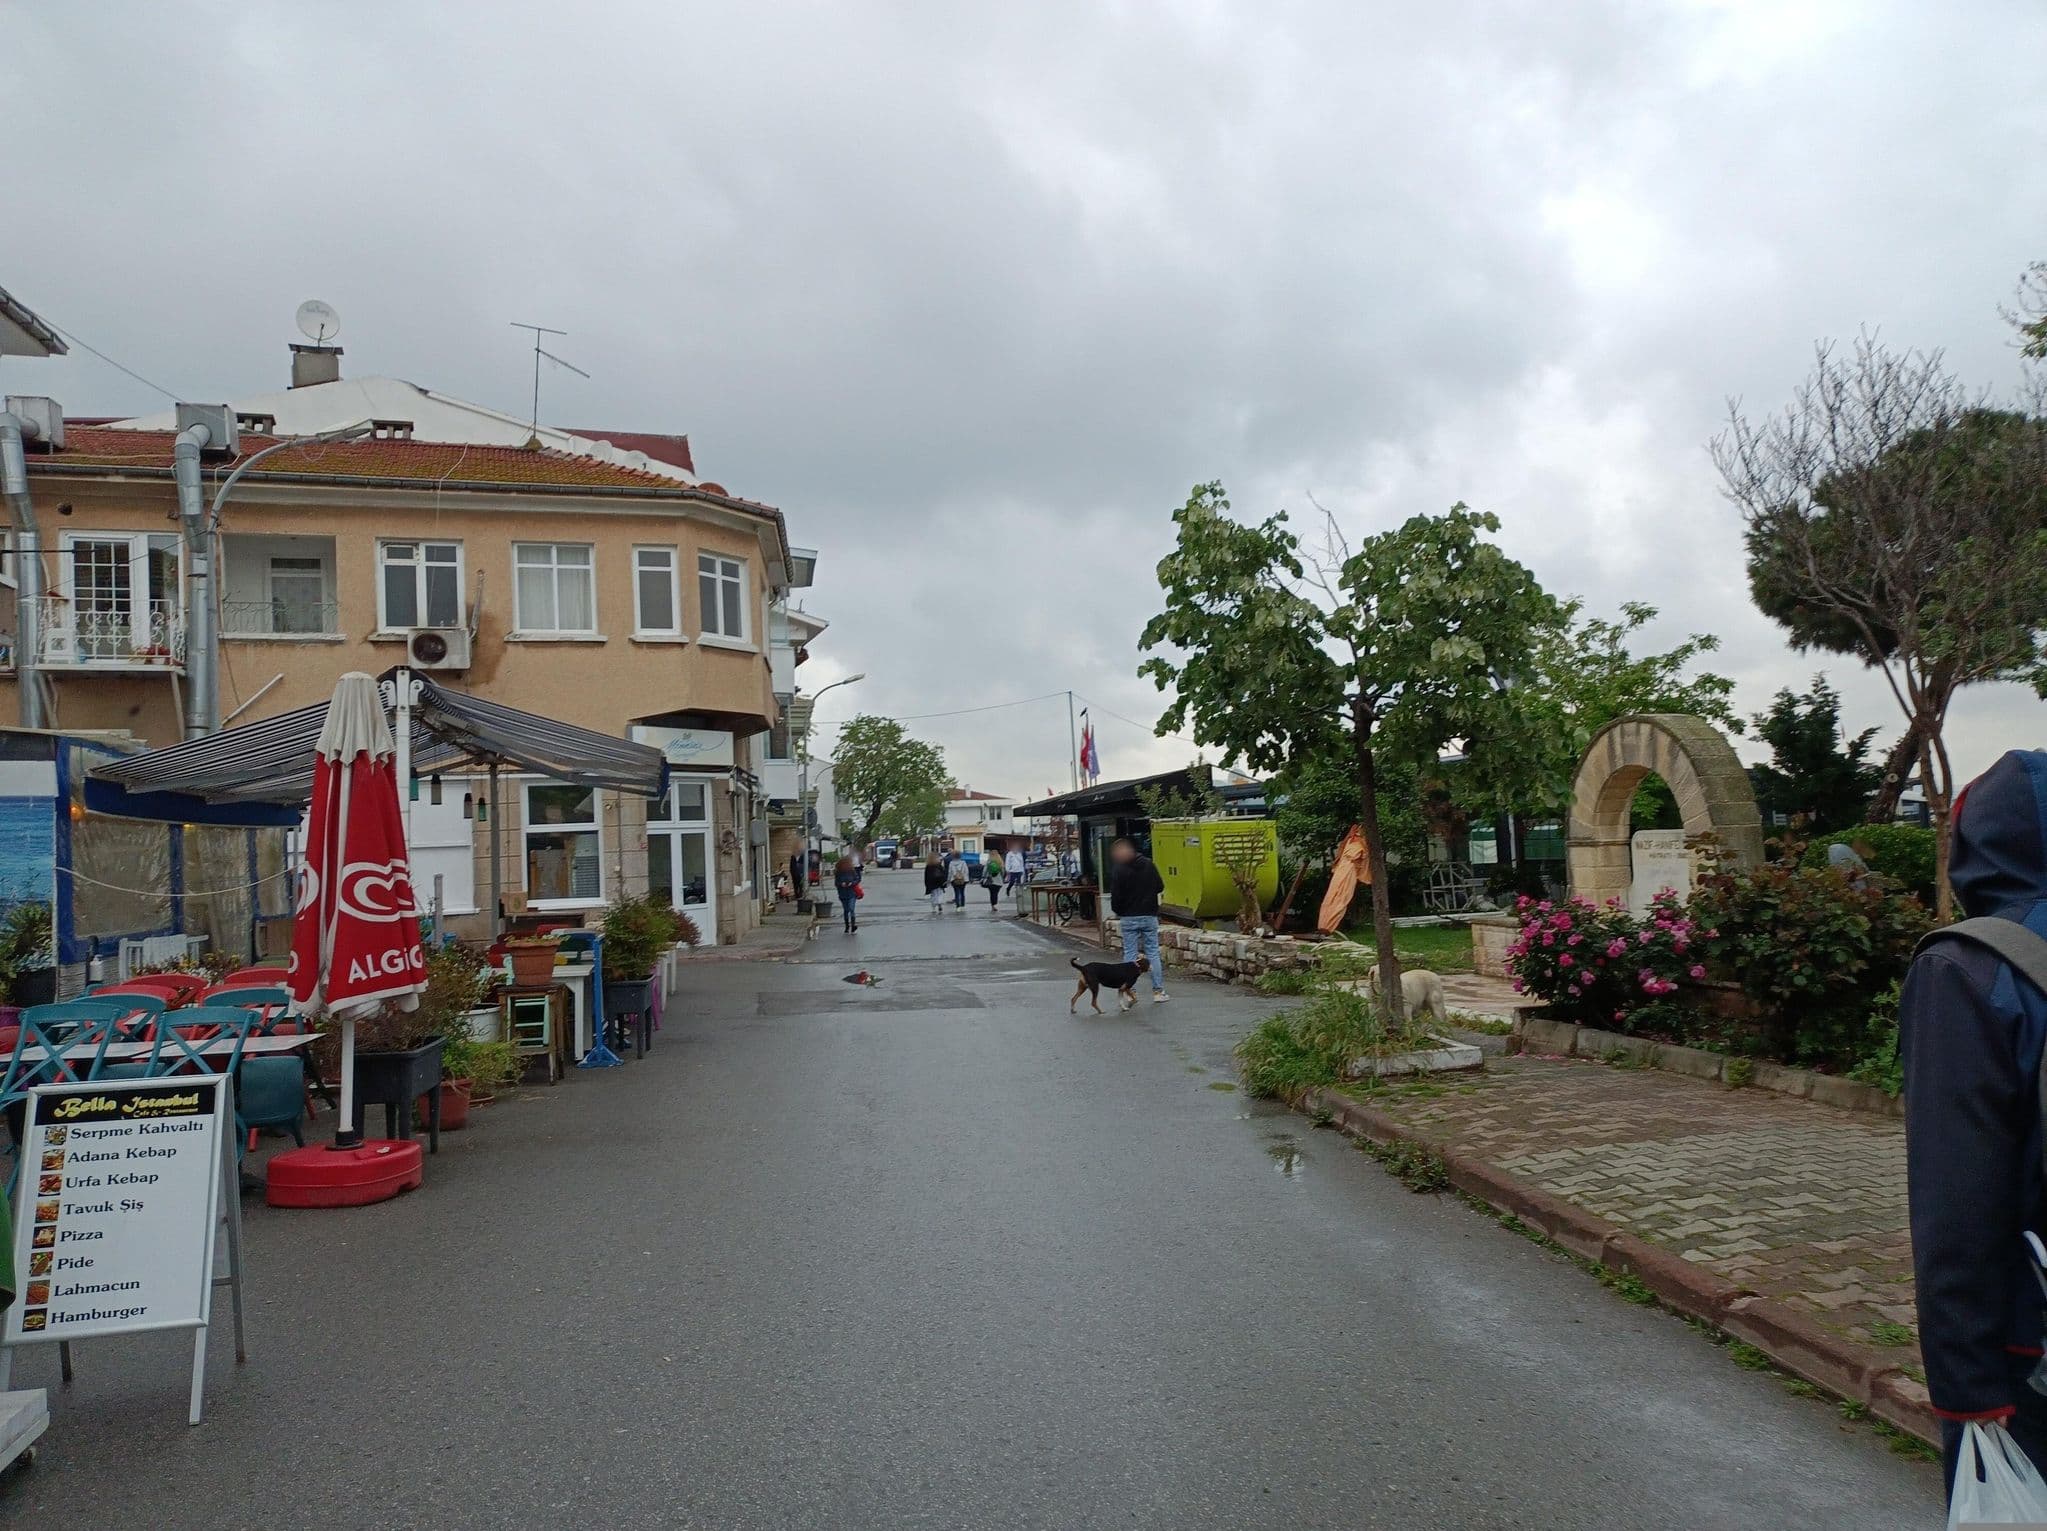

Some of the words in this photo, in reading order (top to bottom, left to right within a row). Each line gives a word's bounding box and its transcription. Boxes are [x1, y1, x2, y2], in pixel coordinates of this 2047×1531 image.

[70, 1126, 134, 1140] Serpme
[138, 1121, 204, 1138] Kahvaltı
[67, 1151, 120, 1164] Adana
[126, 1146, 177, 1163] Kebap
[65, 1174, 101, 1189] Urfa
[107, 1172, 159, 1188] Kebap
[64, 1200, 114, 1216] Tavuk
[120, 1198, 144, 1214] Şiş
[60, 1229, 104, 1242] Pizza
[56, 1257, 95, 1270] Pide
[54, 1279, 141, 1298] Lahmacun
[50, 1304, 148, 1325] Hamburger
